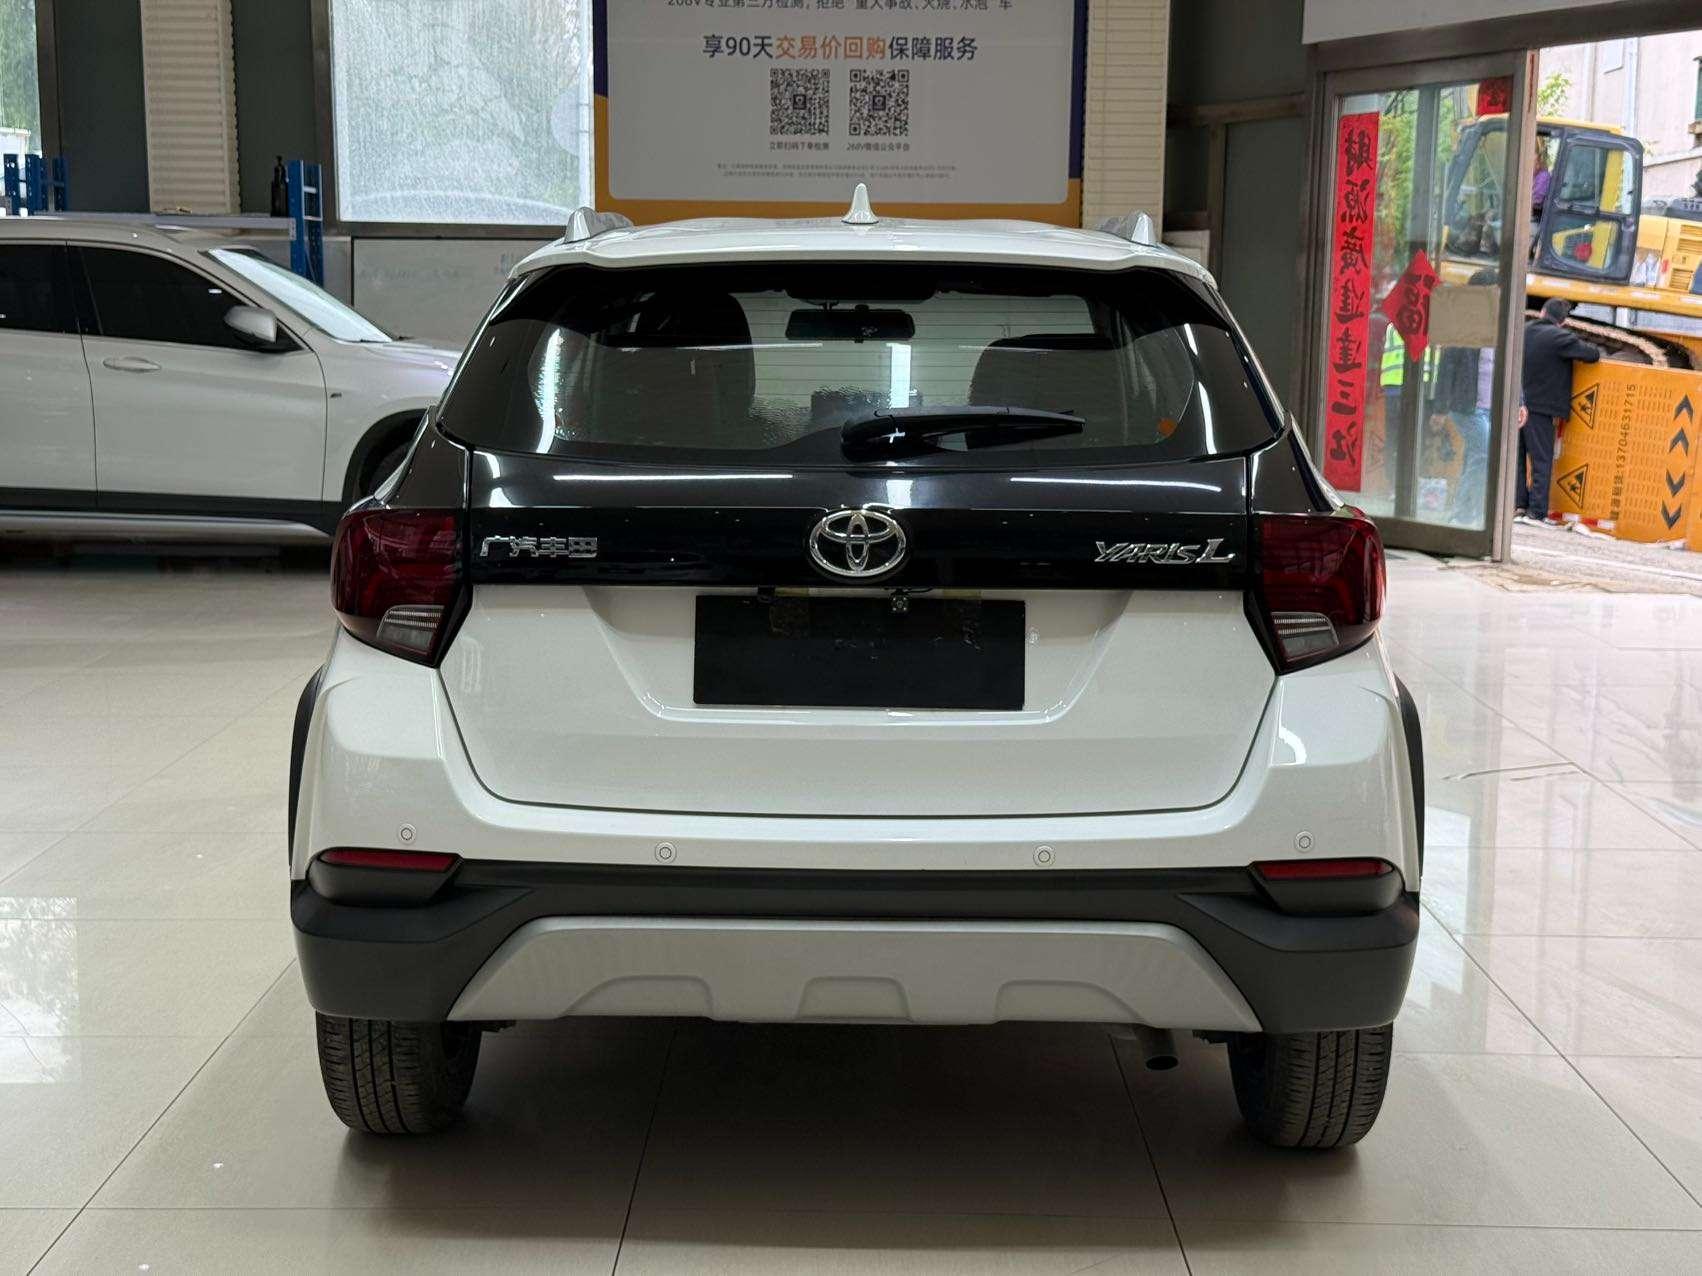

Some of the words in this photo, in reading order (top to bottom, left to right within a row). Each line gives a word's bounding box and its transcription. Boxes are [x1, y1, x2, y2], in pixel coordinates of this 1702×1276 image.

[703, 35, 979, 61] 享90天交易价回购保障服务
[480, 535, 598, 557] 广汽丰田
